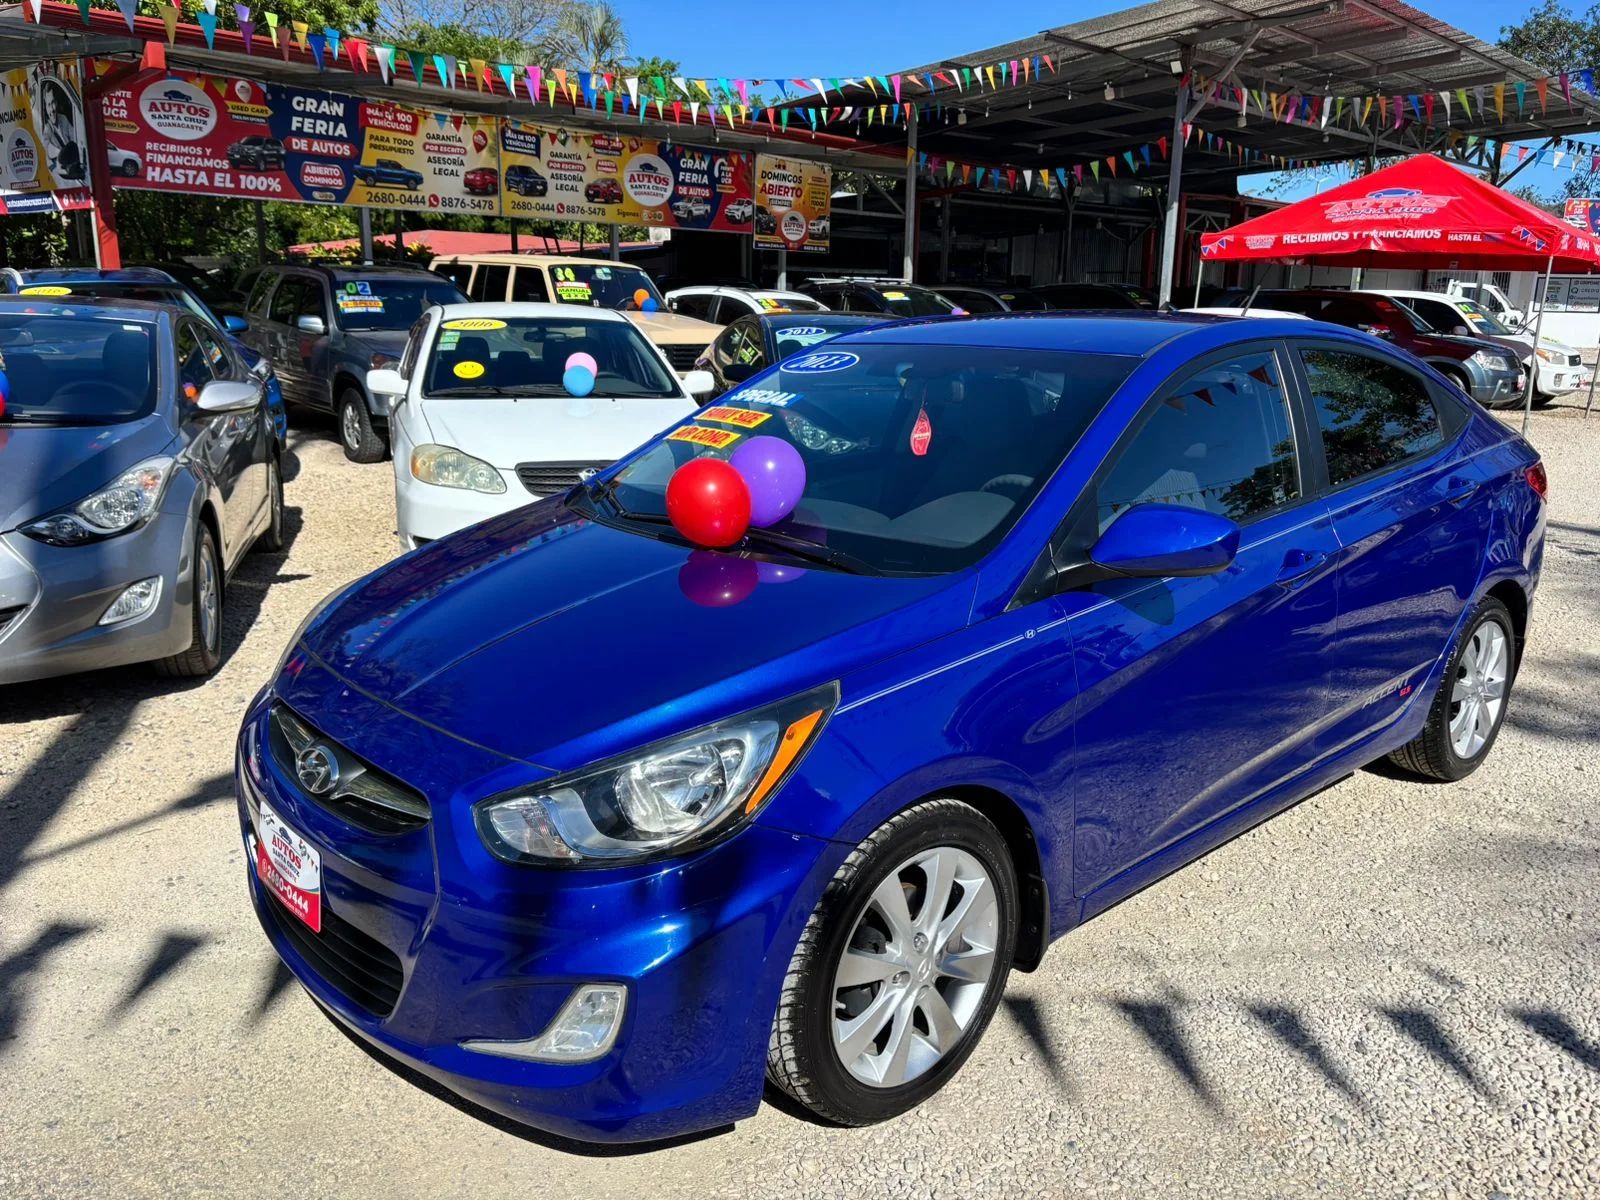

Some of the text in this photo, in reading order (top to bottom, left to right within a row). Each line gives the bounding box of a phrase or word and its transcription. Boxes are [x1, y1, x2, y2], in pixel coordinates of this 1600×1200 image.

[112, 98, 126, 107] LA
[291, 96, 344, 117] GRAN
[102, 107, 127, 118] UCR
[148, 101, 210, 118] AUTOS
[231, 104, 269, 115] USED CARS
[151, 113, 208, 126] SANTA CRUZ
[396, 112, 413, 123] 100
[157, 121, 203, 132] GUANACASTE
[291, 116, 348, 138] FERIA
[369, 134, 414, 147] PARA TODO
[426, 132, 462, 143] GARANTÍA
[525, 134, 536, 143] 100
[145, 142, 212, 156] RECIBIMOS Y
[291, 138, 351, 156] DE AUTOS
[369, 143, 415, 155] PRESUPUESTO
[439, 146, 466, 155] ESCRITO
[11, 149, 34, 162] AUTOS
[146, 152, 230, 169] FINANCIAMOS
[426, 155, 465, 168] ASESORÍA
[550, 151, 582, 161] GARANTÍA
[305, 165, 340, 176] ABIERTO
[561, 163, 584, 171] ESCRITO
[680, 158, 708, 171] GRAN
[146, 166, 282, 192] HASTA EL 100%
[433, 168, 460, 178] LEGAL
[550, 172, 584, 183] ASESORÍA
[679, 171, 709, 184] FERIA
[761, 170, 802, 184] DOMINGOS
[303, 175, 343, 186] DOMINGOS
[629, 173, 669, 187] AUTOS
[555, 184, 579, 193] LEGAL
[678, 186, 688, 195] DE
[689, 187, 710, 198] AUTOS
[760, 183, 803, 198] ABIERTO
[366, 191, 494, 210] 2680-0444 8876-5478
[512, 201, 606, 217] 2680-0444 8876-5478
[1283, 231, 1349, 244] RECIBIMOS
[1353, 231, 1361, 240] Y
[1448, 233, 1471, 241] HASTA
[1473, 234, 1482, 242] EL
[785, 326, 816, 336] 2013
[789, 354, 851, 369] 2013
[730, 388, 797, 407] SPECIAL
[272, 834, 302, 869] AUTOS
[267, 865, 309, 913] 2680-0444
